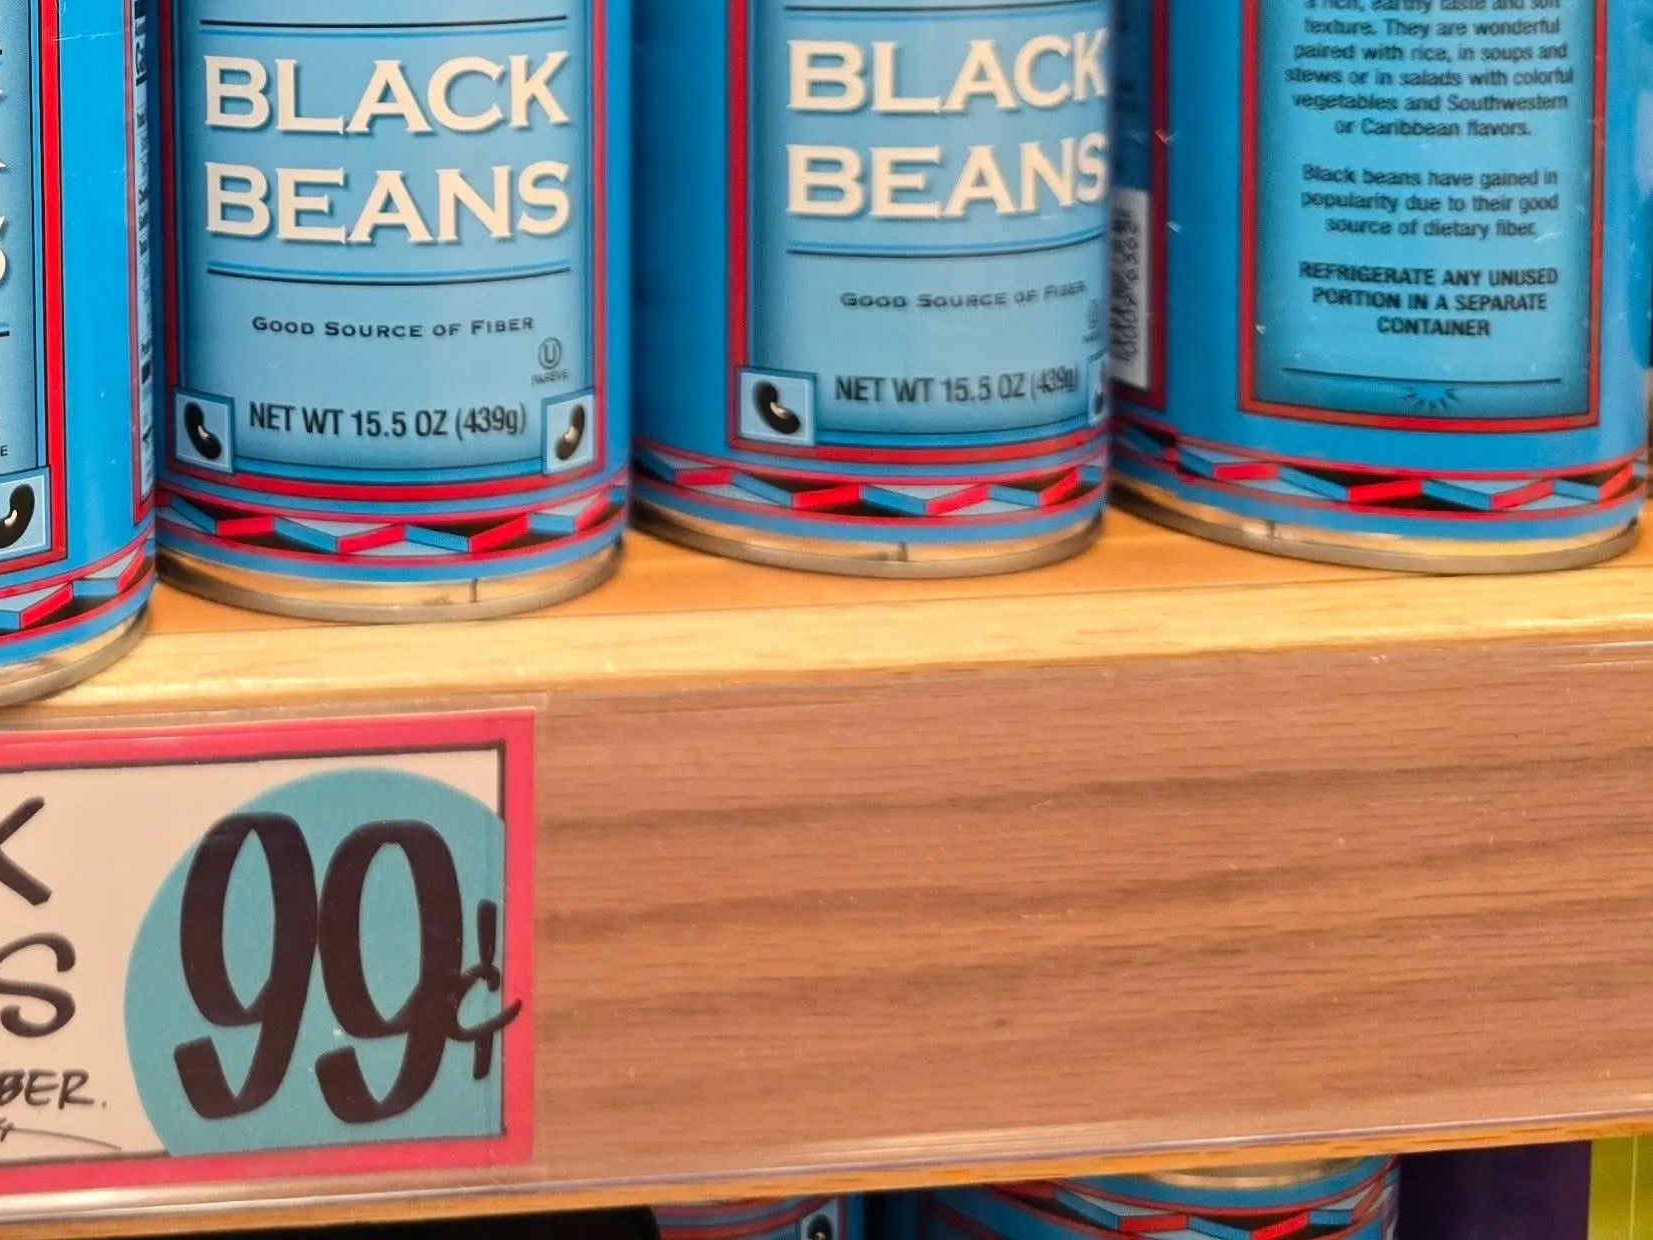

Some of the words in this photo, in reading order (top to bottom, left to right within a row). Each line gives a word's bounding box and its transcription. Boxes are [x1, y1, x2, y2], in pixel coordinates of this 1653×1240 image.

[1385, 18, 1429, 39] They
[1436, 21, 1468, 36] are
[1474, 16, 1560, 36] wonderful
[787, 28, 1107, 114] BLACK
[204, 51, 570, 135] BLACK
[1360, 118, 1459, 137] Caribbean
[786, 132, 1106, 219] BEANS
[1302, 164, 1355, 184] Black
[1363, 168, 1420, 186] beans
[1427, 168, 1474, 187] have
[1480, 168, 1538, 189] gained
[1543, 167, 1557, 184] in
[205, 160, 571, 244] BEANS
[1298, 261, 1435, 286] REFRIGERATE
[1443, 269, 1481, 286] ANY
[1489, 267, 1558, 285] UNUSED
[1312, 286, 1400, 309] PORTION
[1408, 293, 1428, 309] IN
[1435, 294, 1449, 310] A
[1455, 292, 1548, 311] SEPARATE
[1377, 316, 1491, 336] CONTAINER
